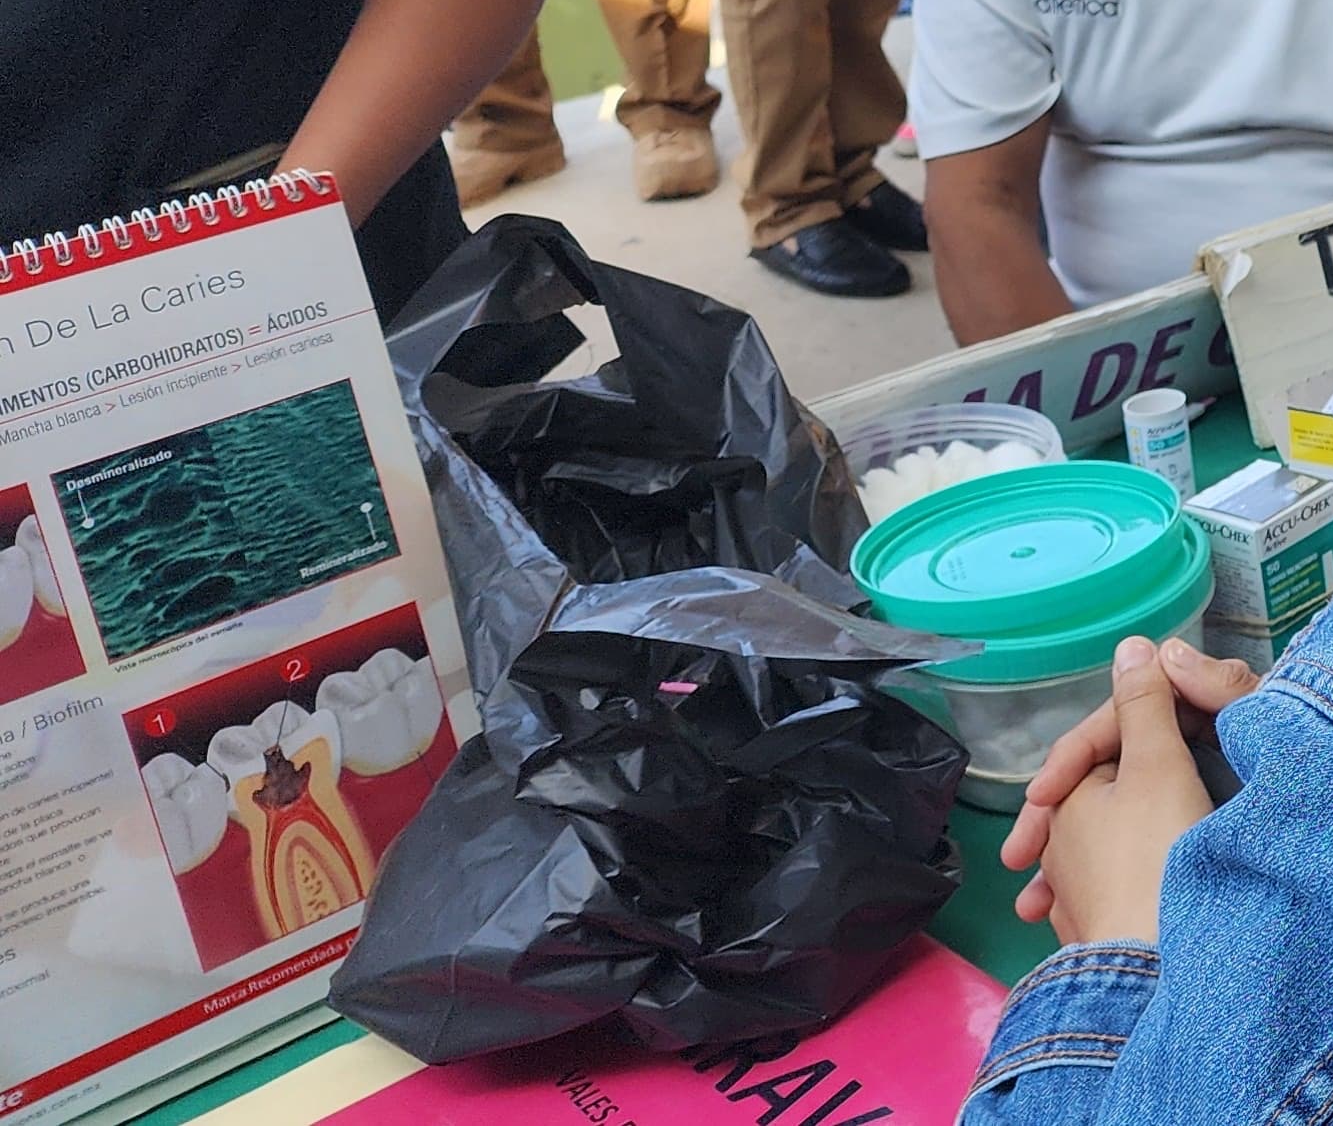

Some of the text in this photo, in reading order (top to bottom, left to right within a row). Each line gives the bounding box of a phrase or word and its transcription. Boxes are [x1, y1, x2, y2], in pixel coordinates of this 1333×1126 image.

[25, 318, 78, 349] De
[87, 302, 131, 331] La
[140, 269, 246, 314] Caries
[86, 327, 244, 392] (CARBOHIDRATOS)
[266, 301, 329, 334] ÁCIDOS
[1071, 317, 1195, 421] DE
[56, 403, 102, 429] blanca
[119, 383, 163, 408] Lesión
[166, 363, 229, 394] incipiente
[244, 345, 288, 369] Lesión
[1263, 496, 1331, 547] ACCU-CHEK
[286, 659, 306, 682] 2
[33, 695, 104, 732] Biofilm
[152, 713, 166, 734] 1
[202, 987, 249, 1015] Marca
[248, 943, 344, 994] Recomendada
